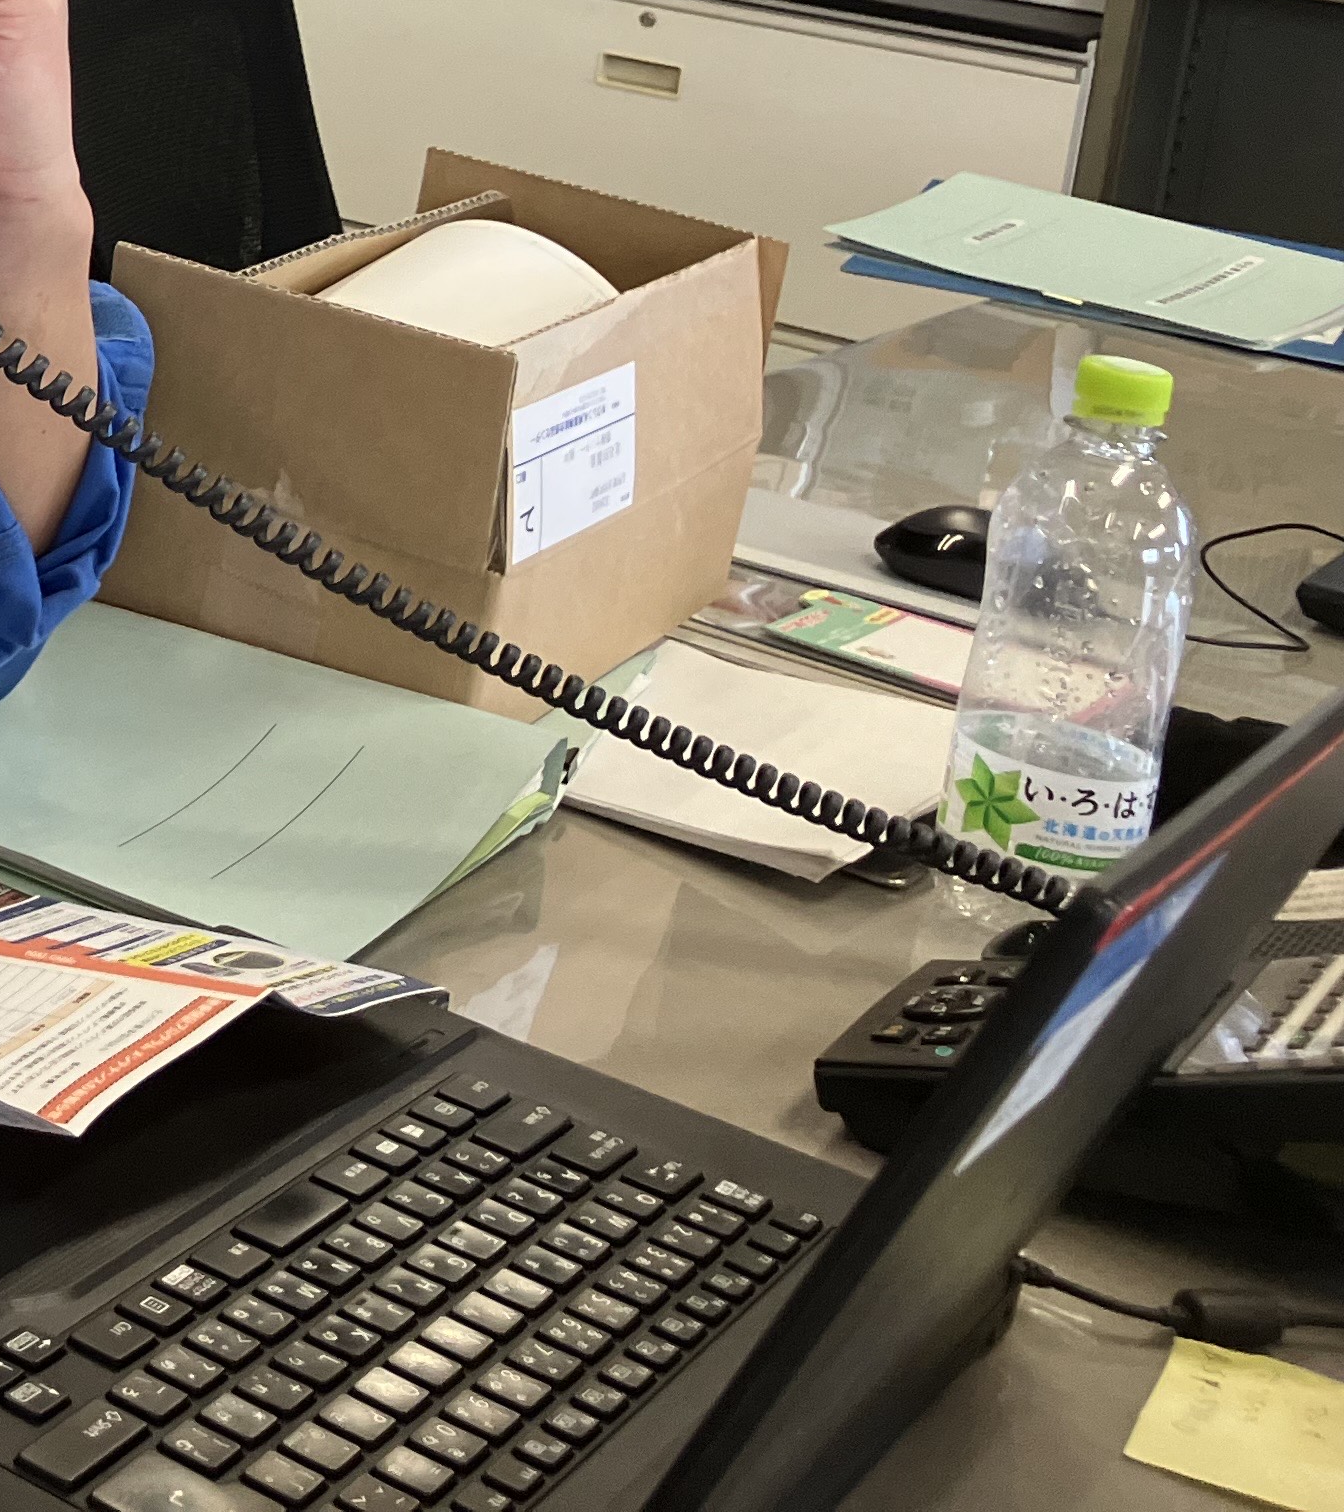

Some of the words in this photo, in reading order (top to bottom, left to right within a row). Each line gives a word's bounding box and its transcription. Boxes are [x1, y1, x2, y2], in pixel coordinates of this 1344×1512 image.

[1044, 817, 1145, 842] 北海道の天然
